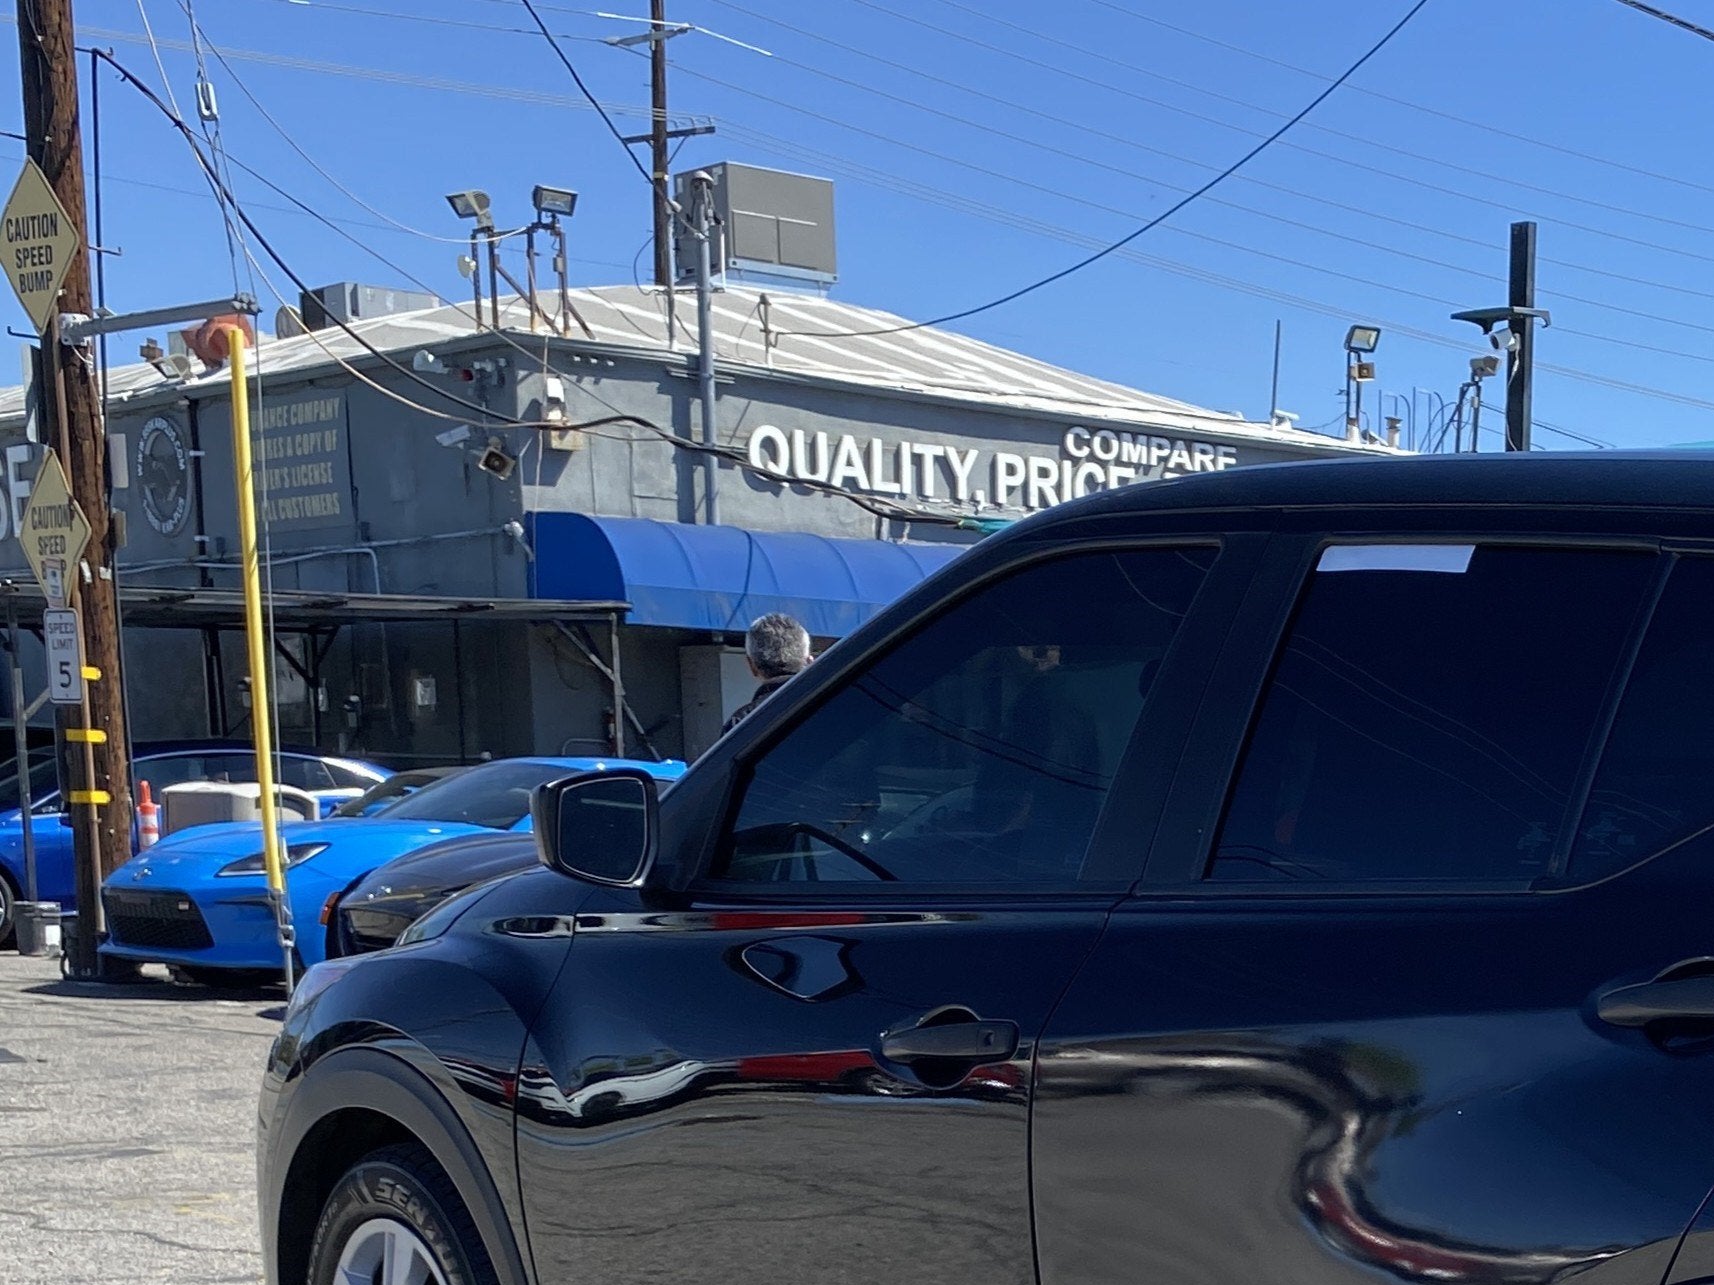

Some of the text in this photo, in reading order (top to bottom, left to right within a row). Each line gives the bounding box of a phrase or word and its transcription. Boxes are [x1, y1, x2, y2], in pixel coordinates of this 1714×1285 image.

[6, 213, 58, 243] CAUTION
[15, 245, 53, 269] SPEED
[19, 270, 53, 293] BUMP
[290, 397, 340, 425] COMPANY
[295, 431, 321, 456] COPY
[324, 429, 338, 453] OF
[1063, 425, 1237, 472] COMPARE
[292, 462, 334, 488] LICENSE
[31, 503, 73, 531] CAUTION
[279, 492, 340, 520] CUSTOMERS
[37, 535, 67, 555] SPEED
[48, 622, 74, 635] SPEED
[51, 638, 74, 650] LIMIT
[58, 661, 72, 688] 5
